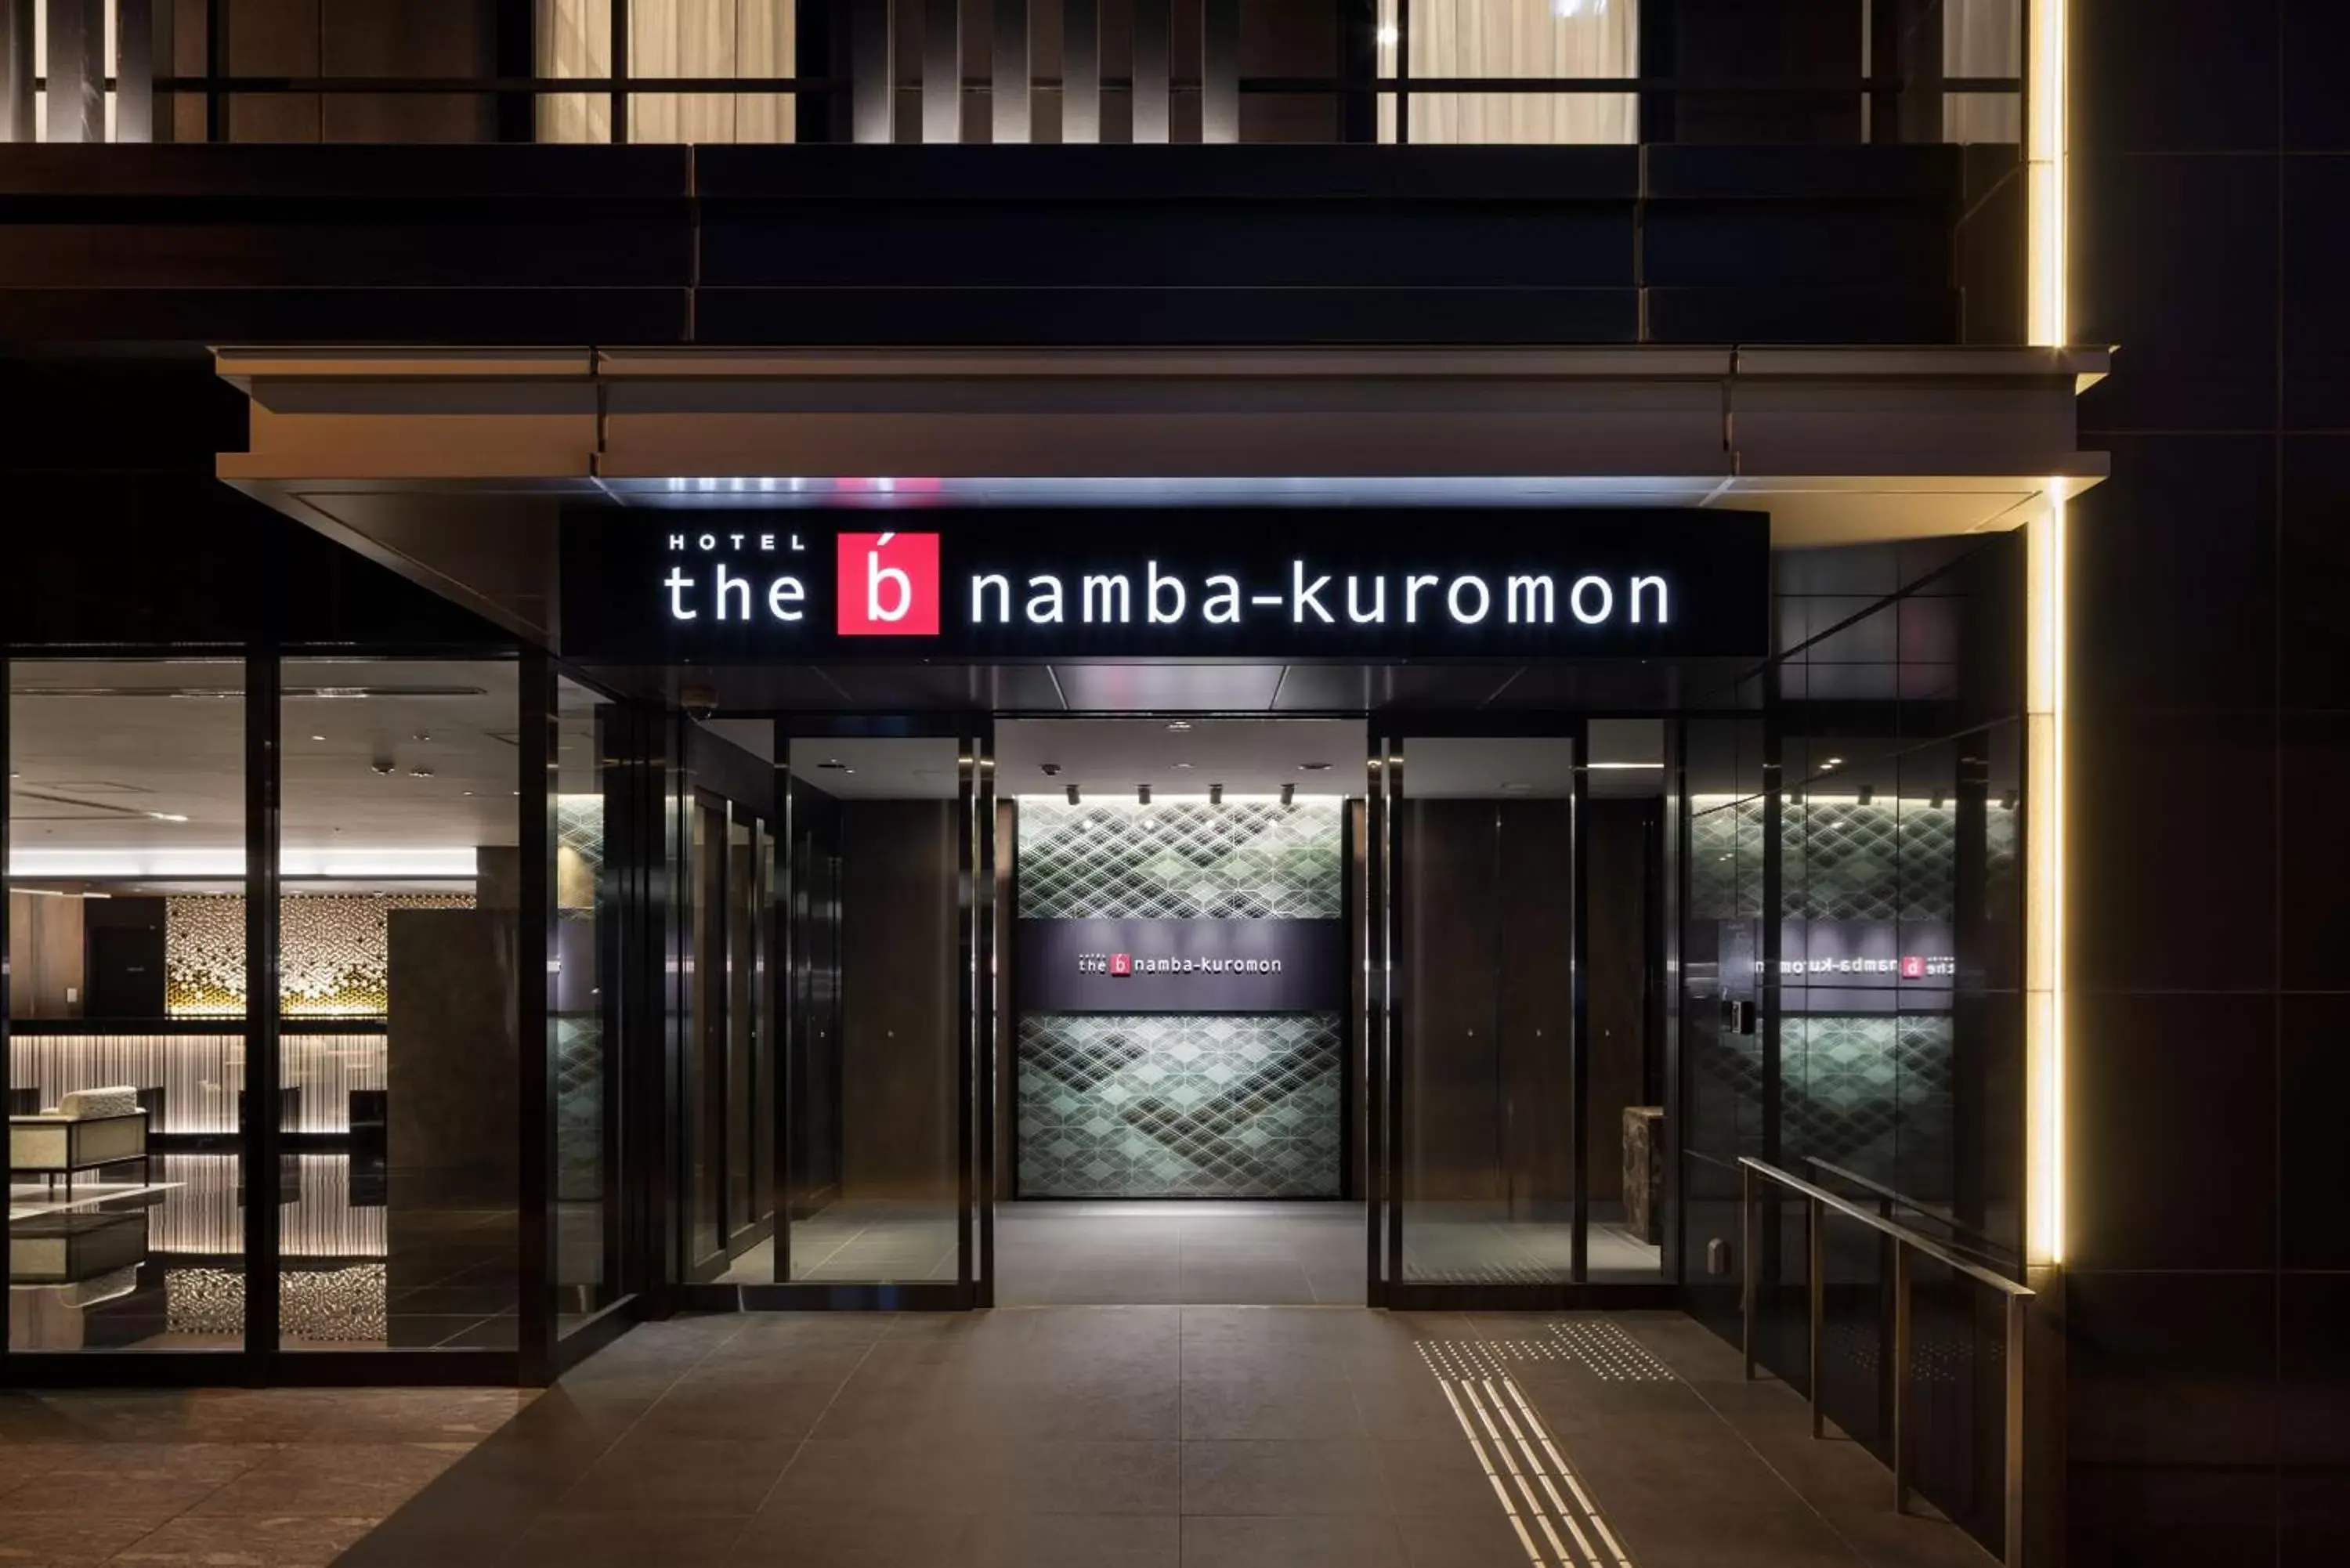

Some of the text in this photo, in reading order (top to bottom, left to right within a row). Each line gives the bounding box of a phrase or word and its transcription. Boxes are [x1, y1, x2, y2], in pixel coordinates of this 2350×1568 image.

[669, 533, 805, 551] HOTEL
[663, 563, 805, 621] the
[971, 560, 1668, 624] namba-kuromon
[1079, 959, 1107, 971] the
[1134, 956, 1282, 972] namba-kuromon
